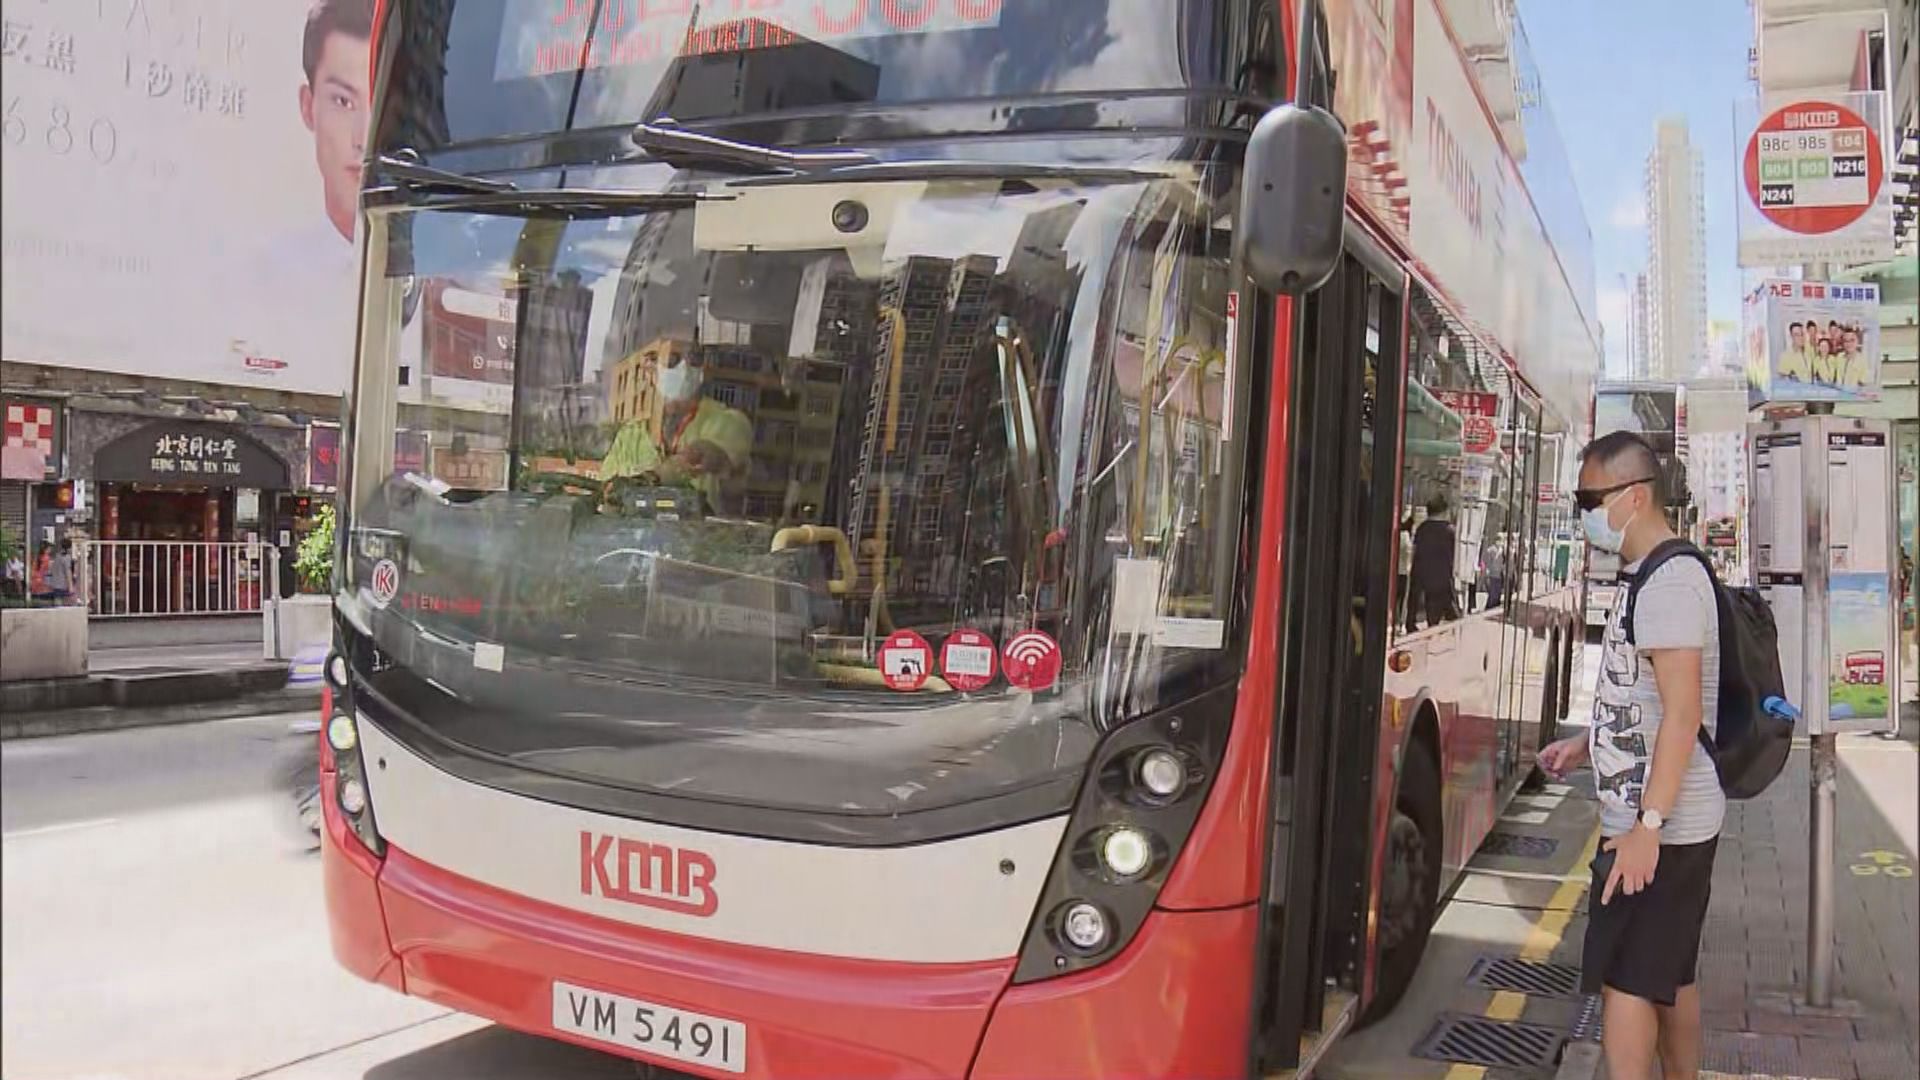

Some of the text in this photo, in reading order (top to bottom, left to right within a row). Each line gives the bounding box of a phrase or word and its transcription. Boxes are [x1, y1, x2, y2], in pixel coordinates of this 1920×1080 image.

[1426, 97, 1482, 241] TOSHIBA
[1762, 188, 1793, 202] N241
[156, 433, 237, 460] 北京同仁堂
[580, 831, 719, 918] KMB
[568, 991, 729, 1063] VM 5491
